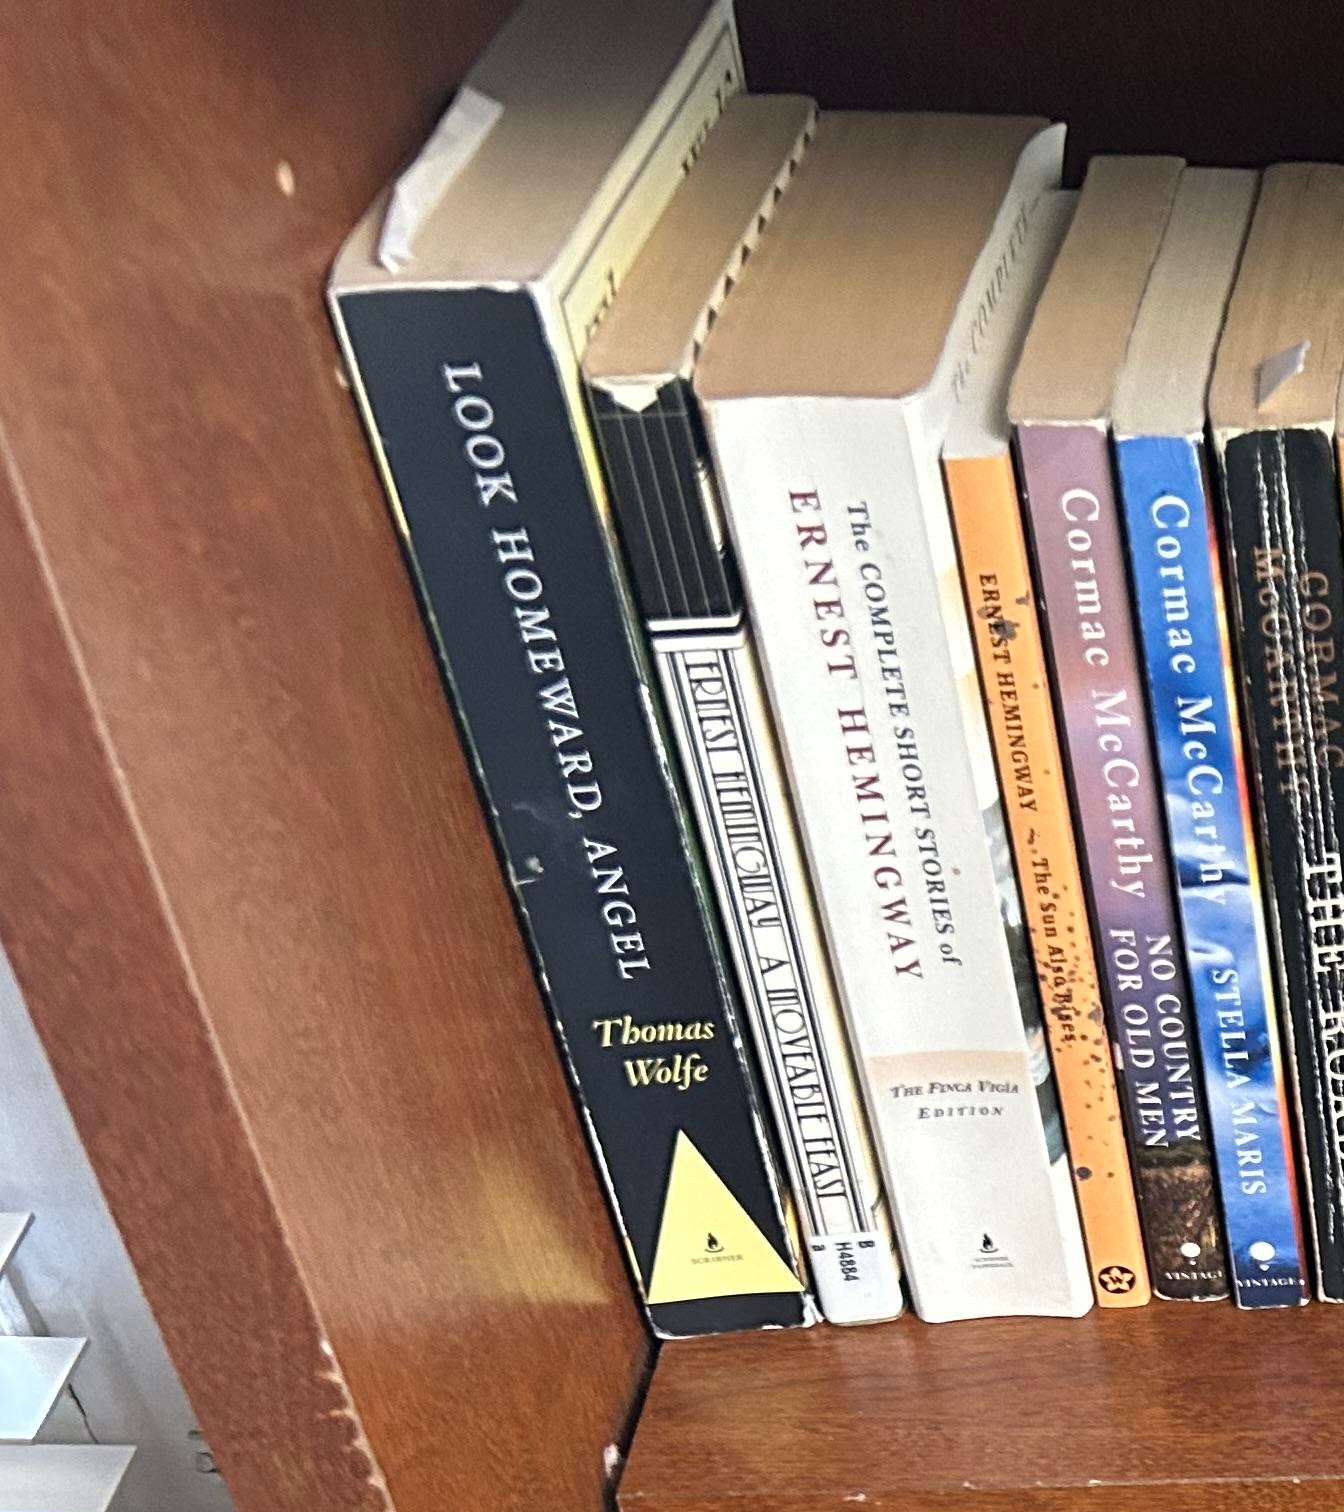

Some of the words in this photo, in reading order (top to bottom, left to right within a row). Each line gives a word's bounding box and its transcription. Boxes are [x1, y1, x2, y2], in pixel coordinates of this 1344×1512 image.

[442, 359, 519, 506] LOOK
[491, 525, 605, 820] HOMEWARD,
[584, 835, 652, 980] ANGEL
[788, 488, 858, 681] ERNEST
[837, 704, 924, 981] HEMINGWAY
[848, 502, 869, 554] The
[860, 562, 910, 718] COMPLETE
[894, 726, 930, 818] SHORT
[916, 827, 956, 935] STORIES
[939, 942, 963, 966] of
[592, 1016, 715, 1048] Thomas
[624, 1055, 710, 1087] Wolfe
